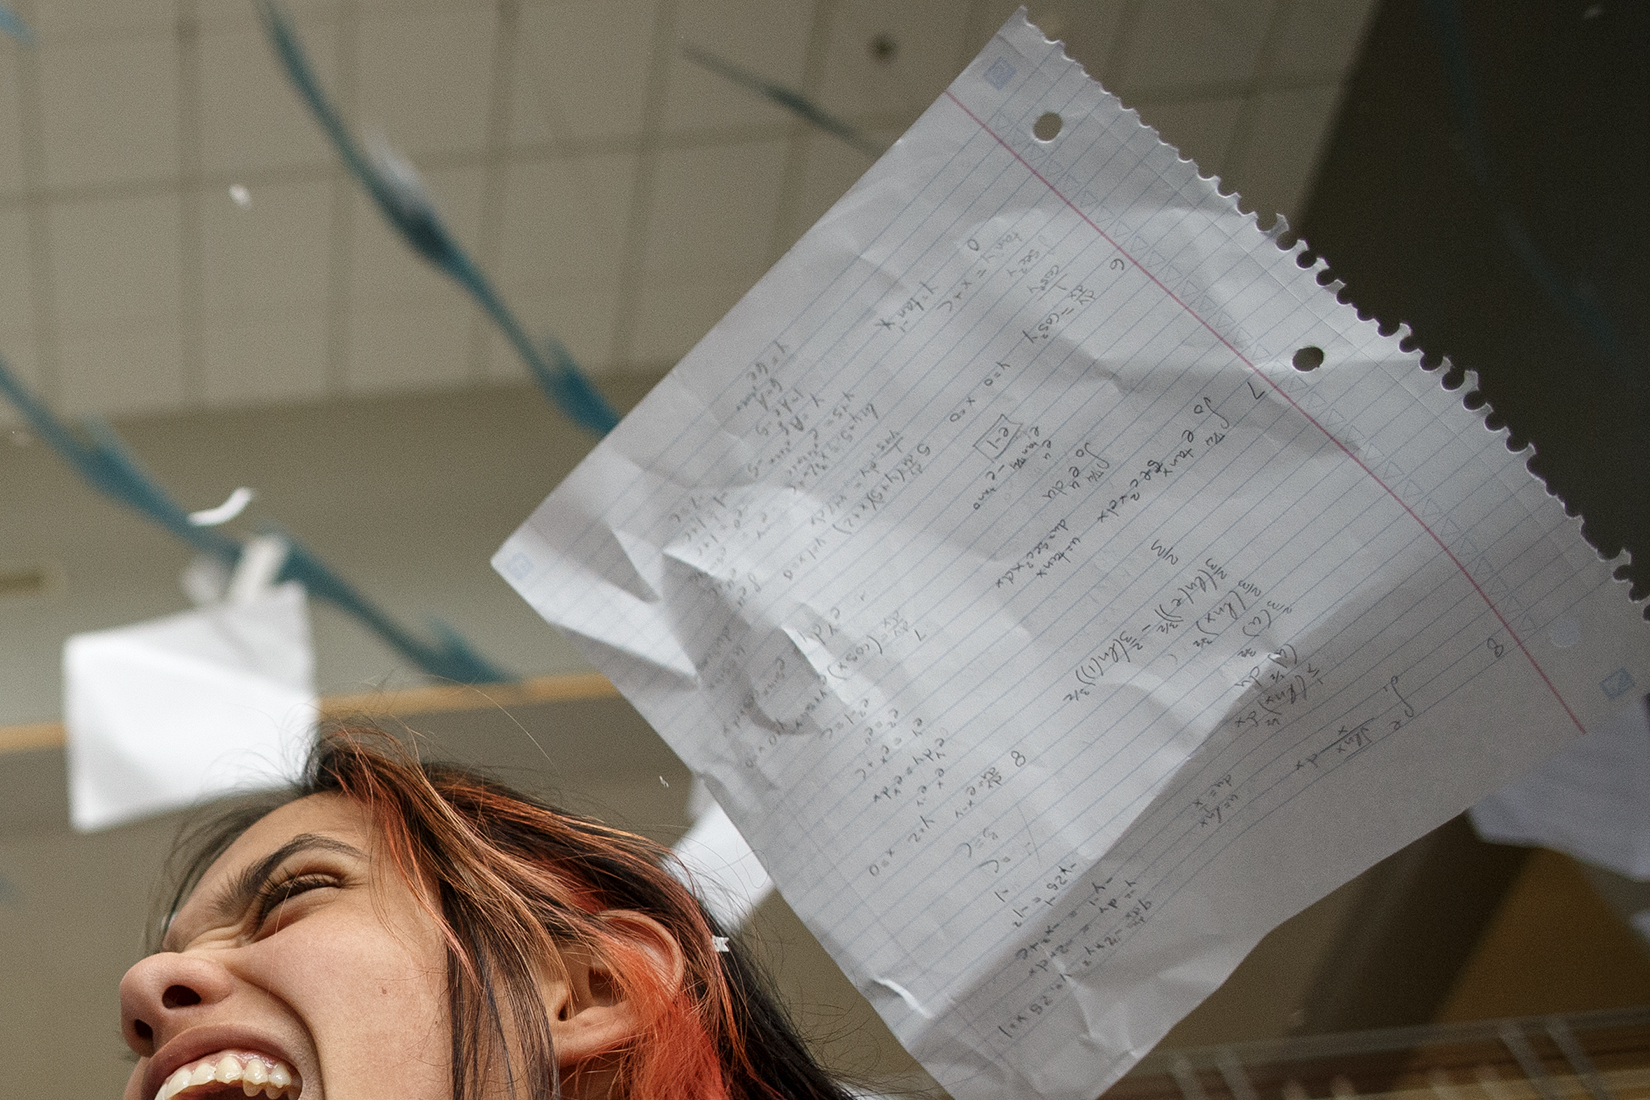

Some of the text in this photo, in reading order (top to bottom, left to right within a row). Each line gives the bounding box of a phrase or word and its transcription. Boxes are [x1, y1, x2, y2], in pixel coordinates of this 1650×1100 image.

[1108, 257, 1126, 274] 6
[1246, 380, 1265, 401] 7
[915, 441, 931, 457] 5
[1482, 634, 1506, 658] 8
[1007, 748, 1027, 768] 8
